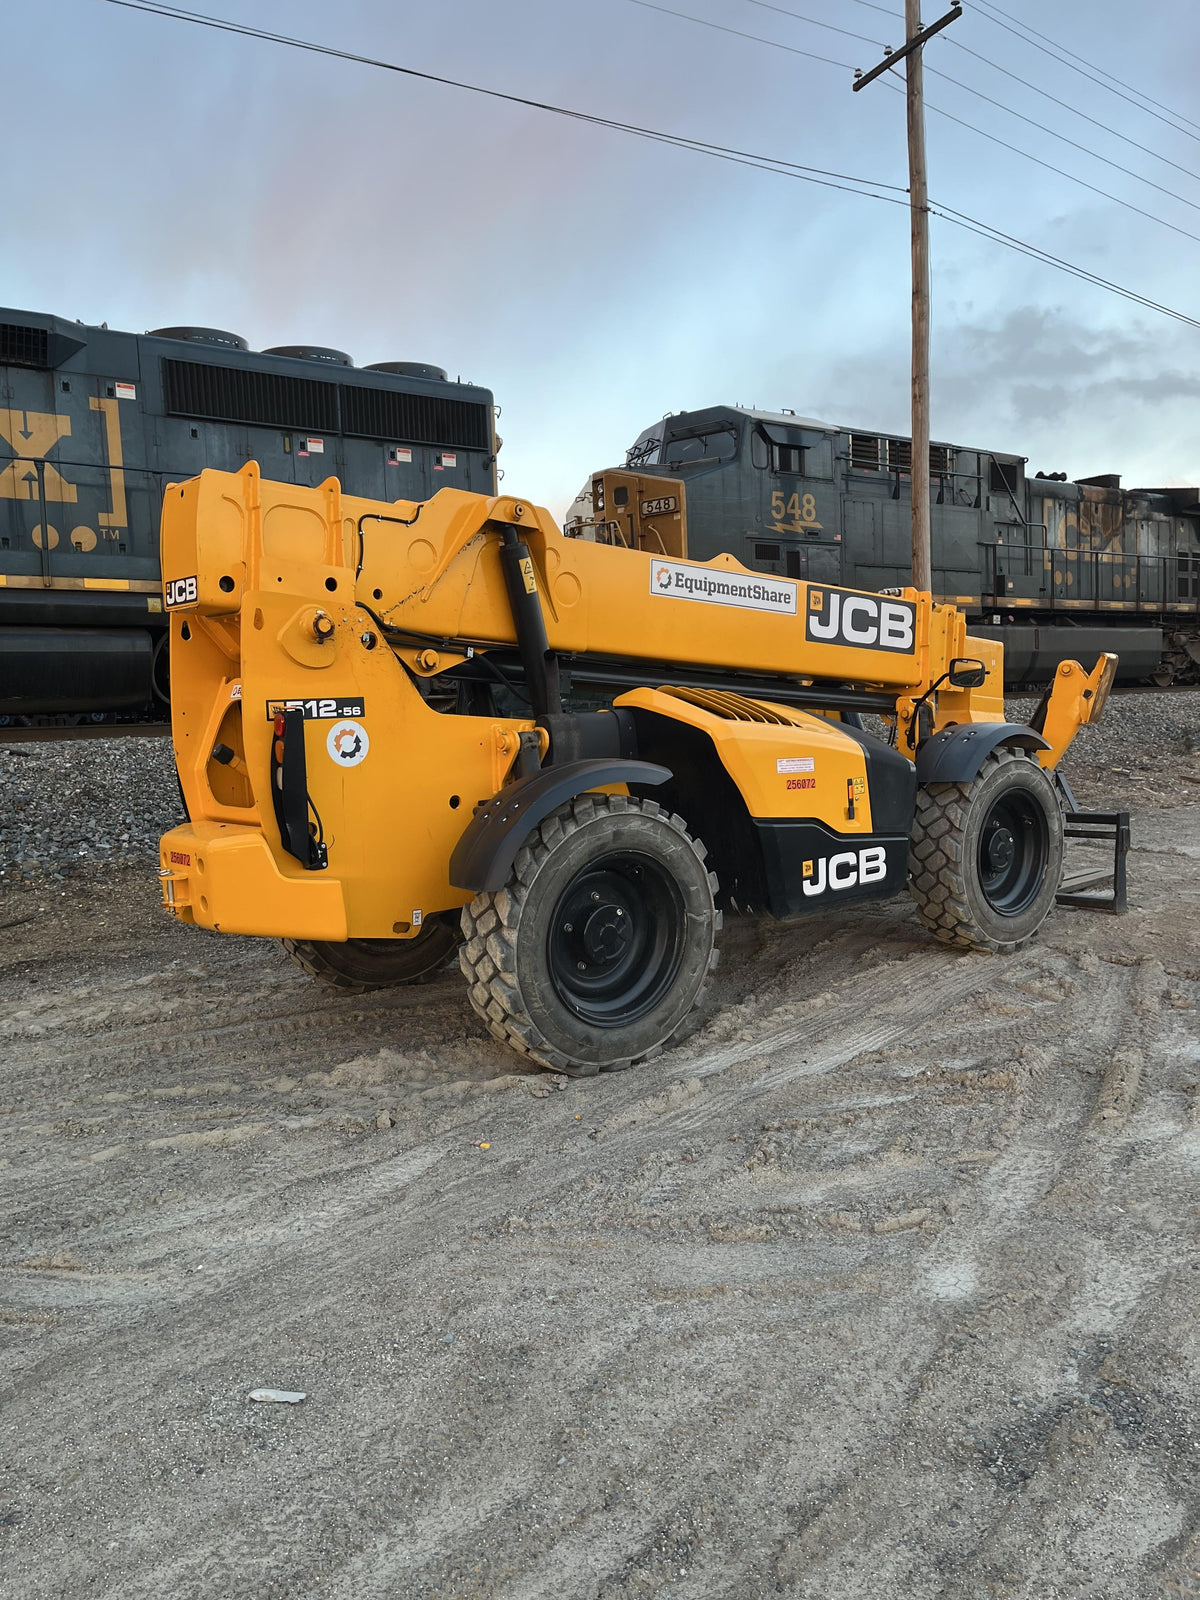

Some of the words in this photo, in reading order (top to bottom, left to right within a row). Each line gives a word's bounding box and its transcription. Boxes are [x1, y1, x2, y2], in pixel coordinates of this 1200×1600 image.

[646, 498, 671, 514] 548
[771, 491, 816, 522] 548
[100, 528, 120, 540] TM
[166, 577, 197, 605] JCB
[674, 572, 791, 605] EquipmentShare
[809, 593, 913, 649] JCB
[787, 778, 816, 790] 256072
[803, 846, 887, 896] JCB
